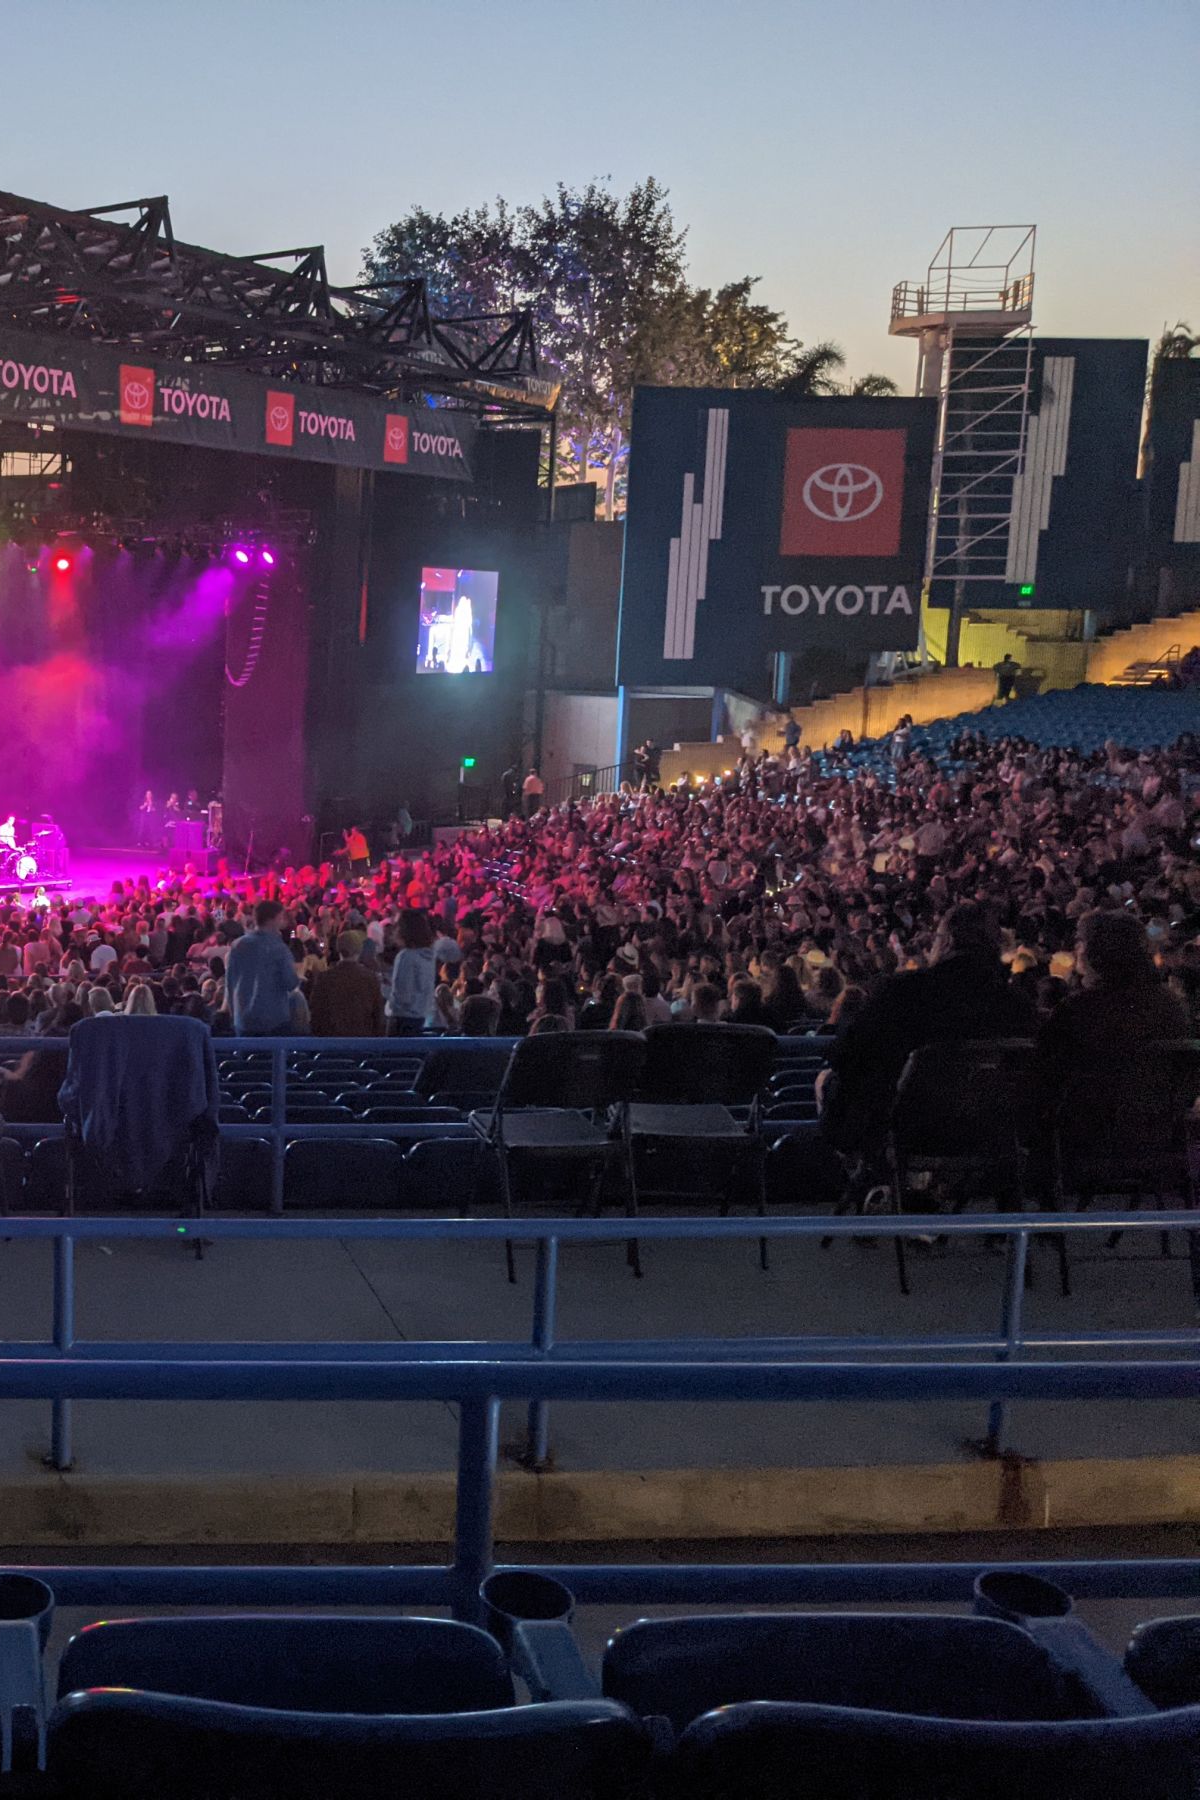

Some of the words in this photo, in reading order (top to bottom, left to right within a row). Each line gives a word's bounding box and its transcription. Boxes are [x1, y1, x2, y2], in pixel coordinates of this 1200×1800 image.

[159, 387, 232, 422] TOYOTA
[299, 411, 356, 441] TOYOTA
[412, 431, 464, 458] TOYOTA
[761, 584, 913, 615] TOYOTA
